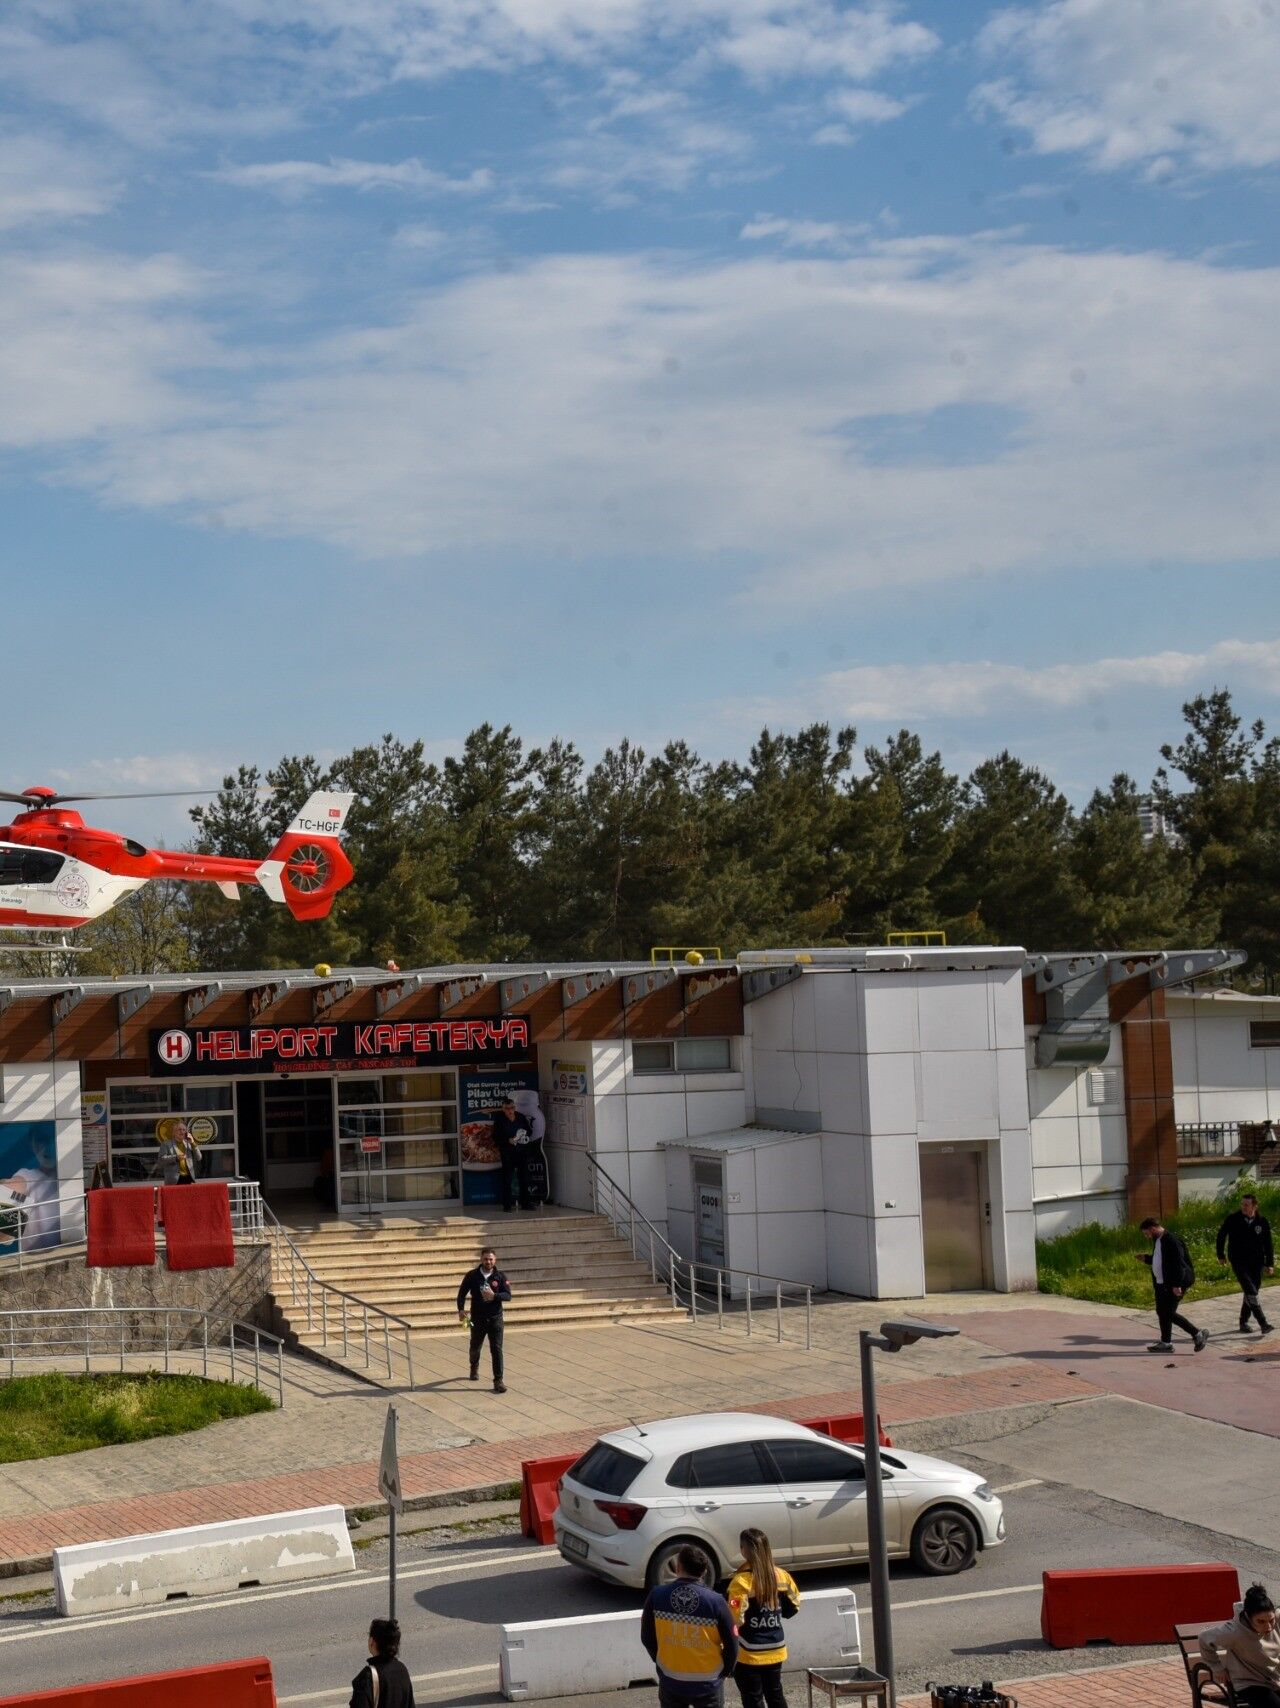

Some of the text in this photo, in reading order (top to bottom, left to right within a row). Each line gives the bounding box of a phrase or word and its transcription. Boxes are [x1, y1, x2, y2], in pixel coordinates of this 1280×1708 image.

[299, 818, 340, 832] TC-HGF
[355, 1019, 528, 1054] KAFETERYA
[468, 1089, 491, 1098] Pilav
[468, 1100, 479, 1108] Et
